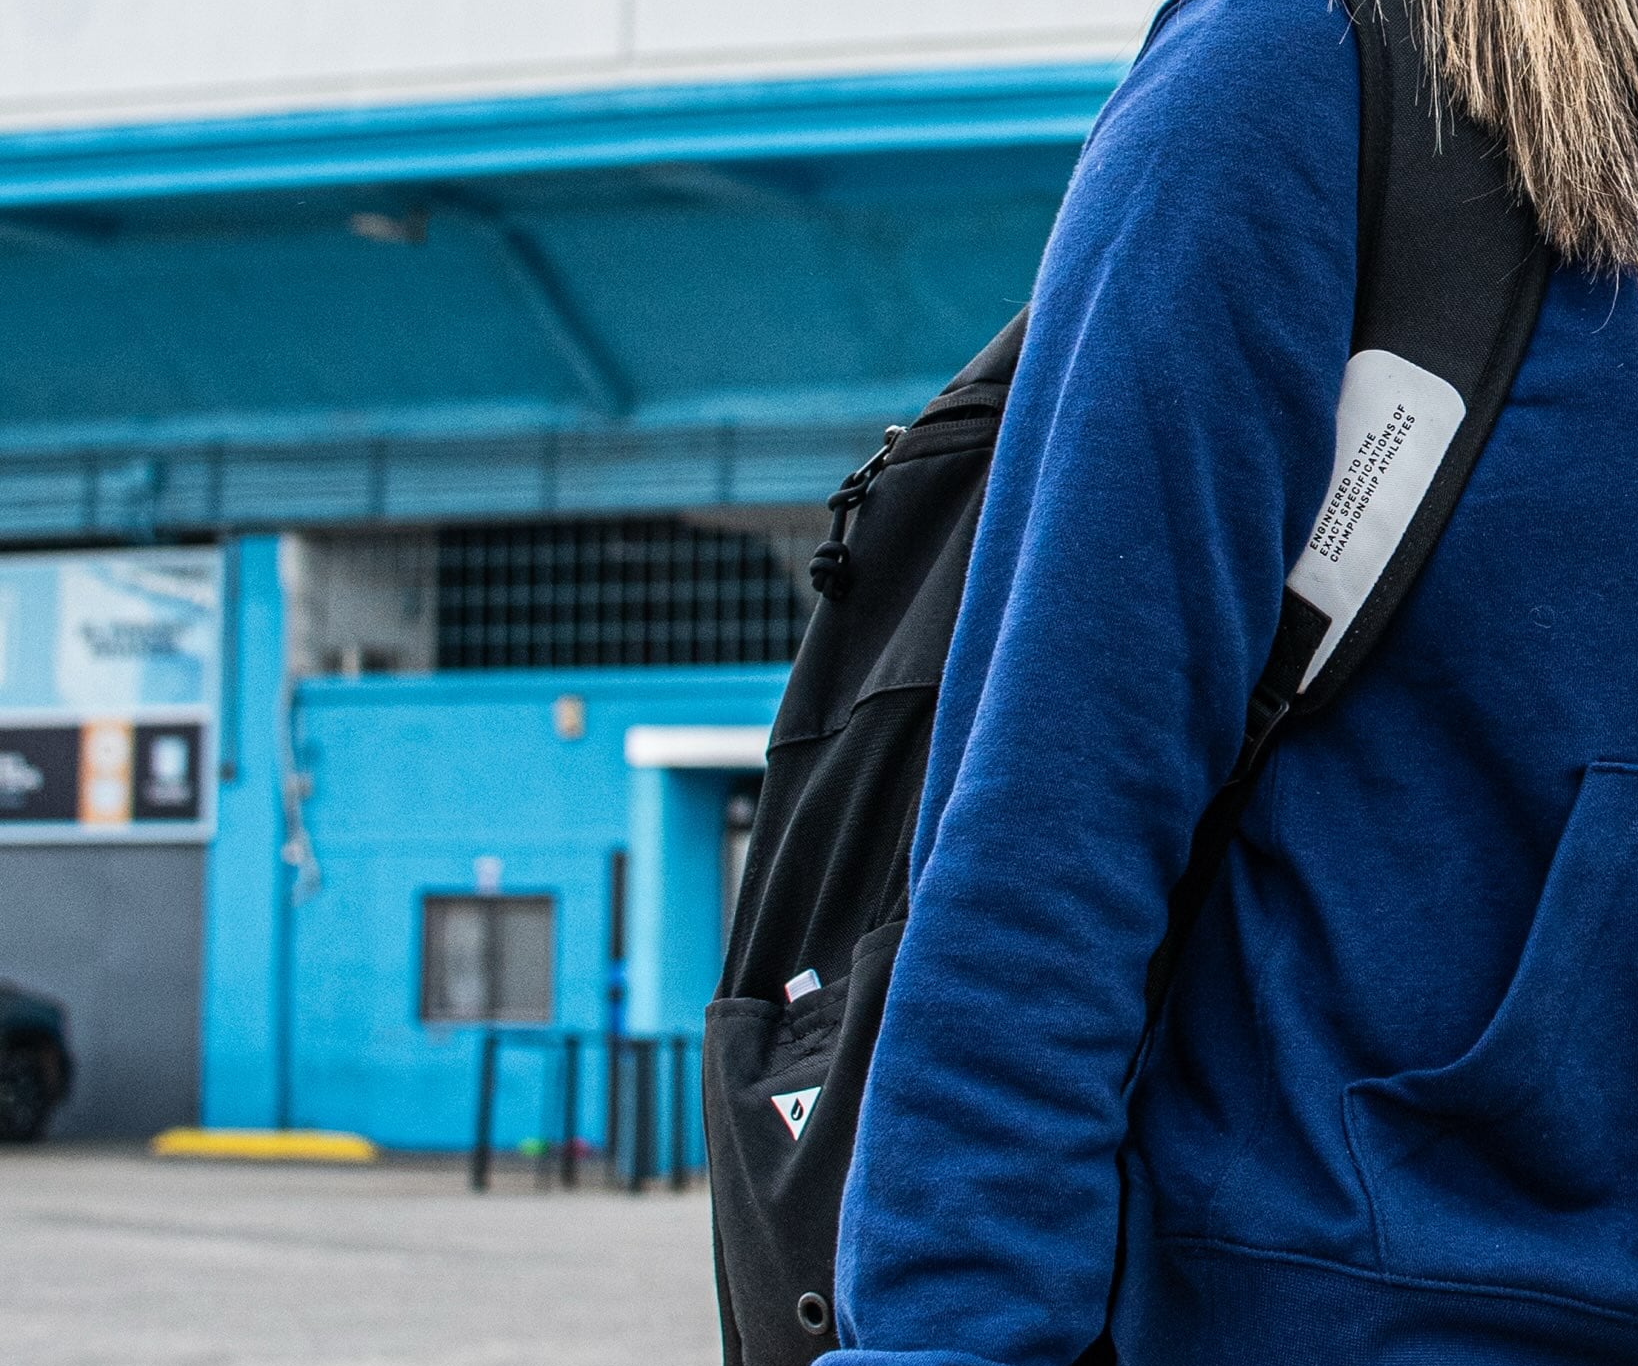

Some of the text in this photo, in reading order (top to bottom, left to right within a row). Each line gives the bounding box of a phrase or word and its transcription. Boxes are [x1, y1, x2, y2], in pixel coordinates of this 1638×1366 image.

[1309, 432, 1376, 550] ENGINEERED TO THE
[1320, 403, 1406, 556] EXACT SPECIFICATIONS OF
[1330, 415, 1416, 563] CHAMPIONSHIP ATHLETES
